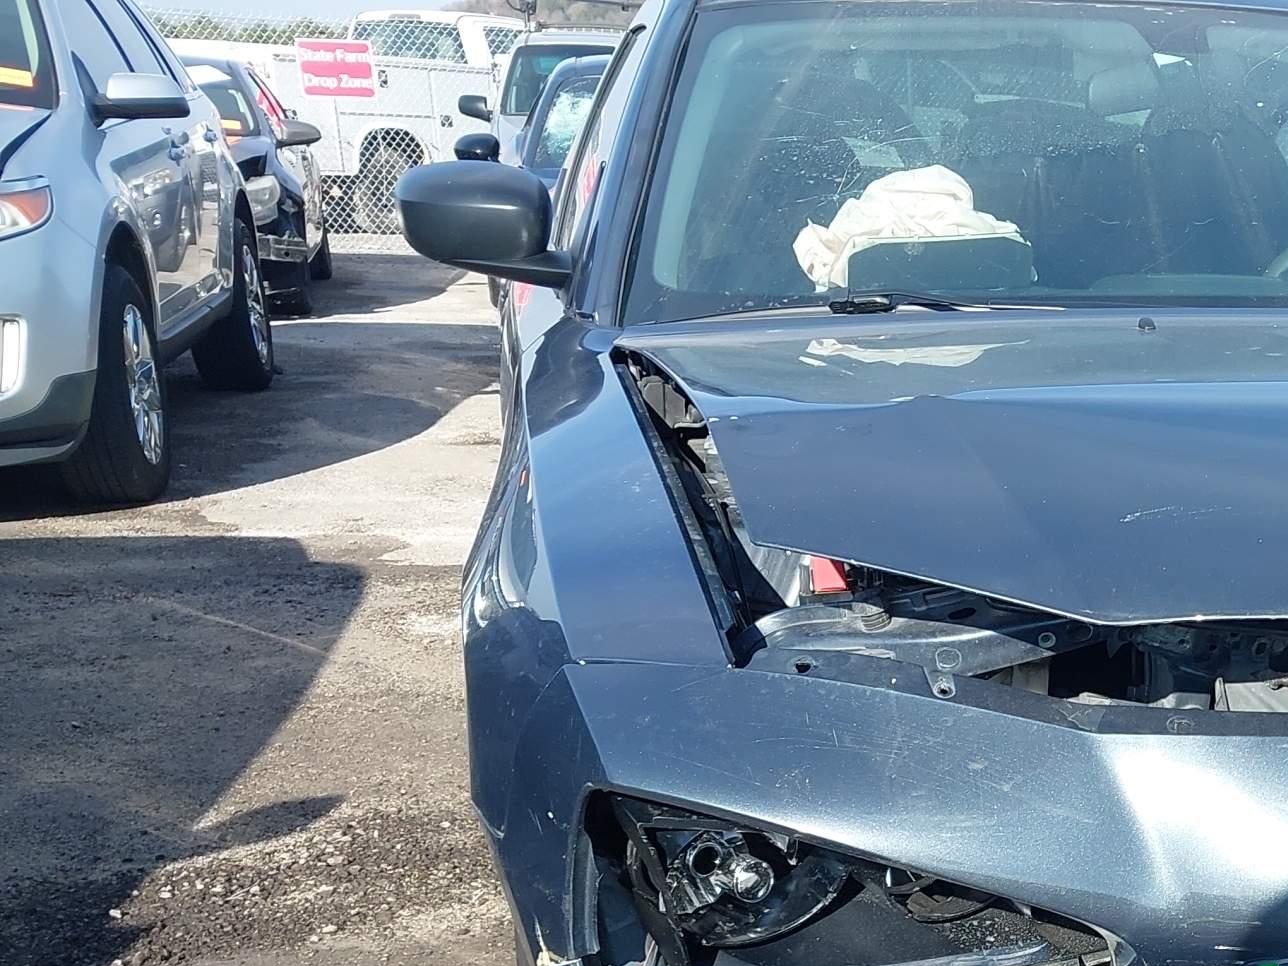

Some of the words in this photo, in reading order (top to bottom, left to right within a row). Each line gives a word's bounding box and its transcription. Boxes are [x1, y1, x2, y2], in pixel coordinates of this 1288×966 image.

[299, 48, 335, 62] State
[335, 49, 370, 63] Farm
[303, 72, 338, 89] Drop
[339, 74, 374, 88] Zone
